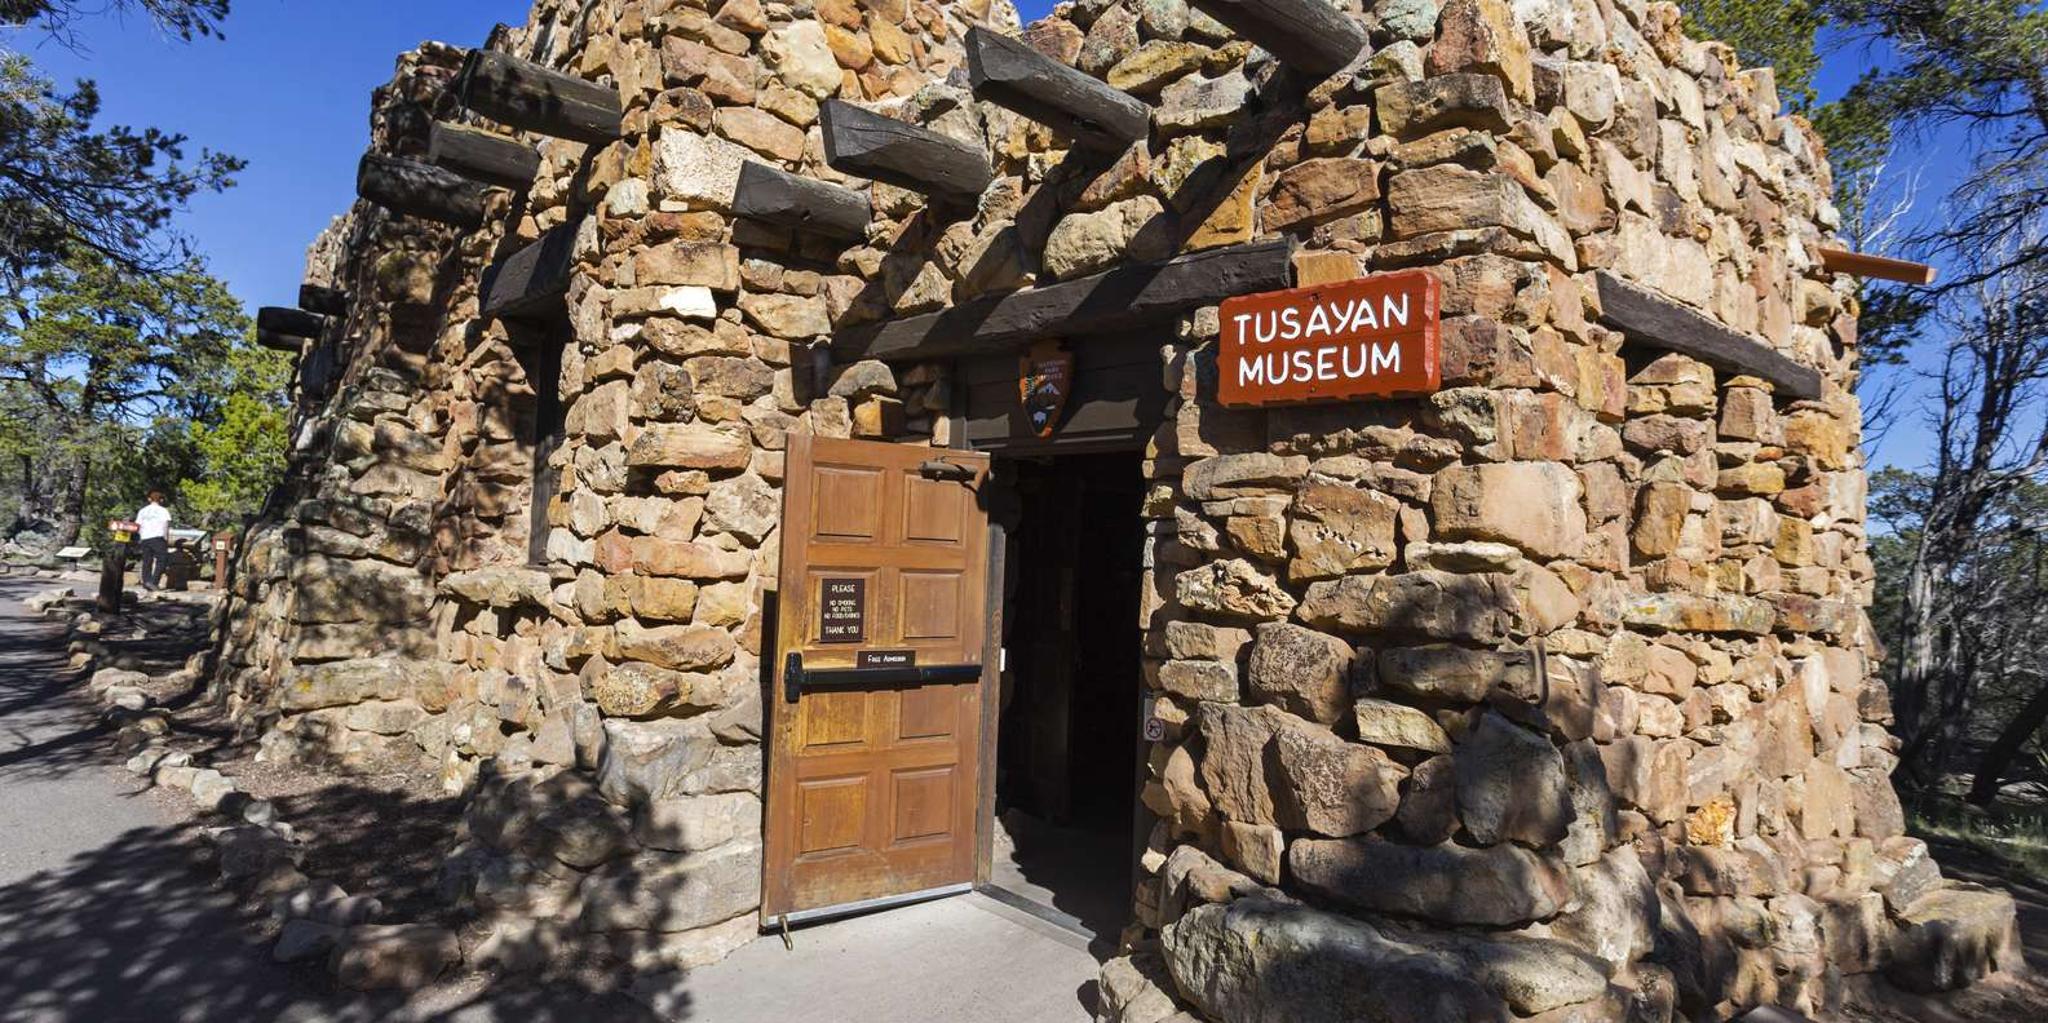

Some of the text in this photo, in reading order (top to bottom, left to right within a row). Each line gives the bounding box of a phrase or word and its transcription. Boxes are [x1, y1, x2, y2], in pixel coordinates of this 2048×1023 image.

[1234, 293, 1408, 345] TUSAYAN
[1238, 341, 1400, 387] MUSEUM
[831, 584, 856, 593] PLEASE
[825, 626, 859, 634] THANK YOU
